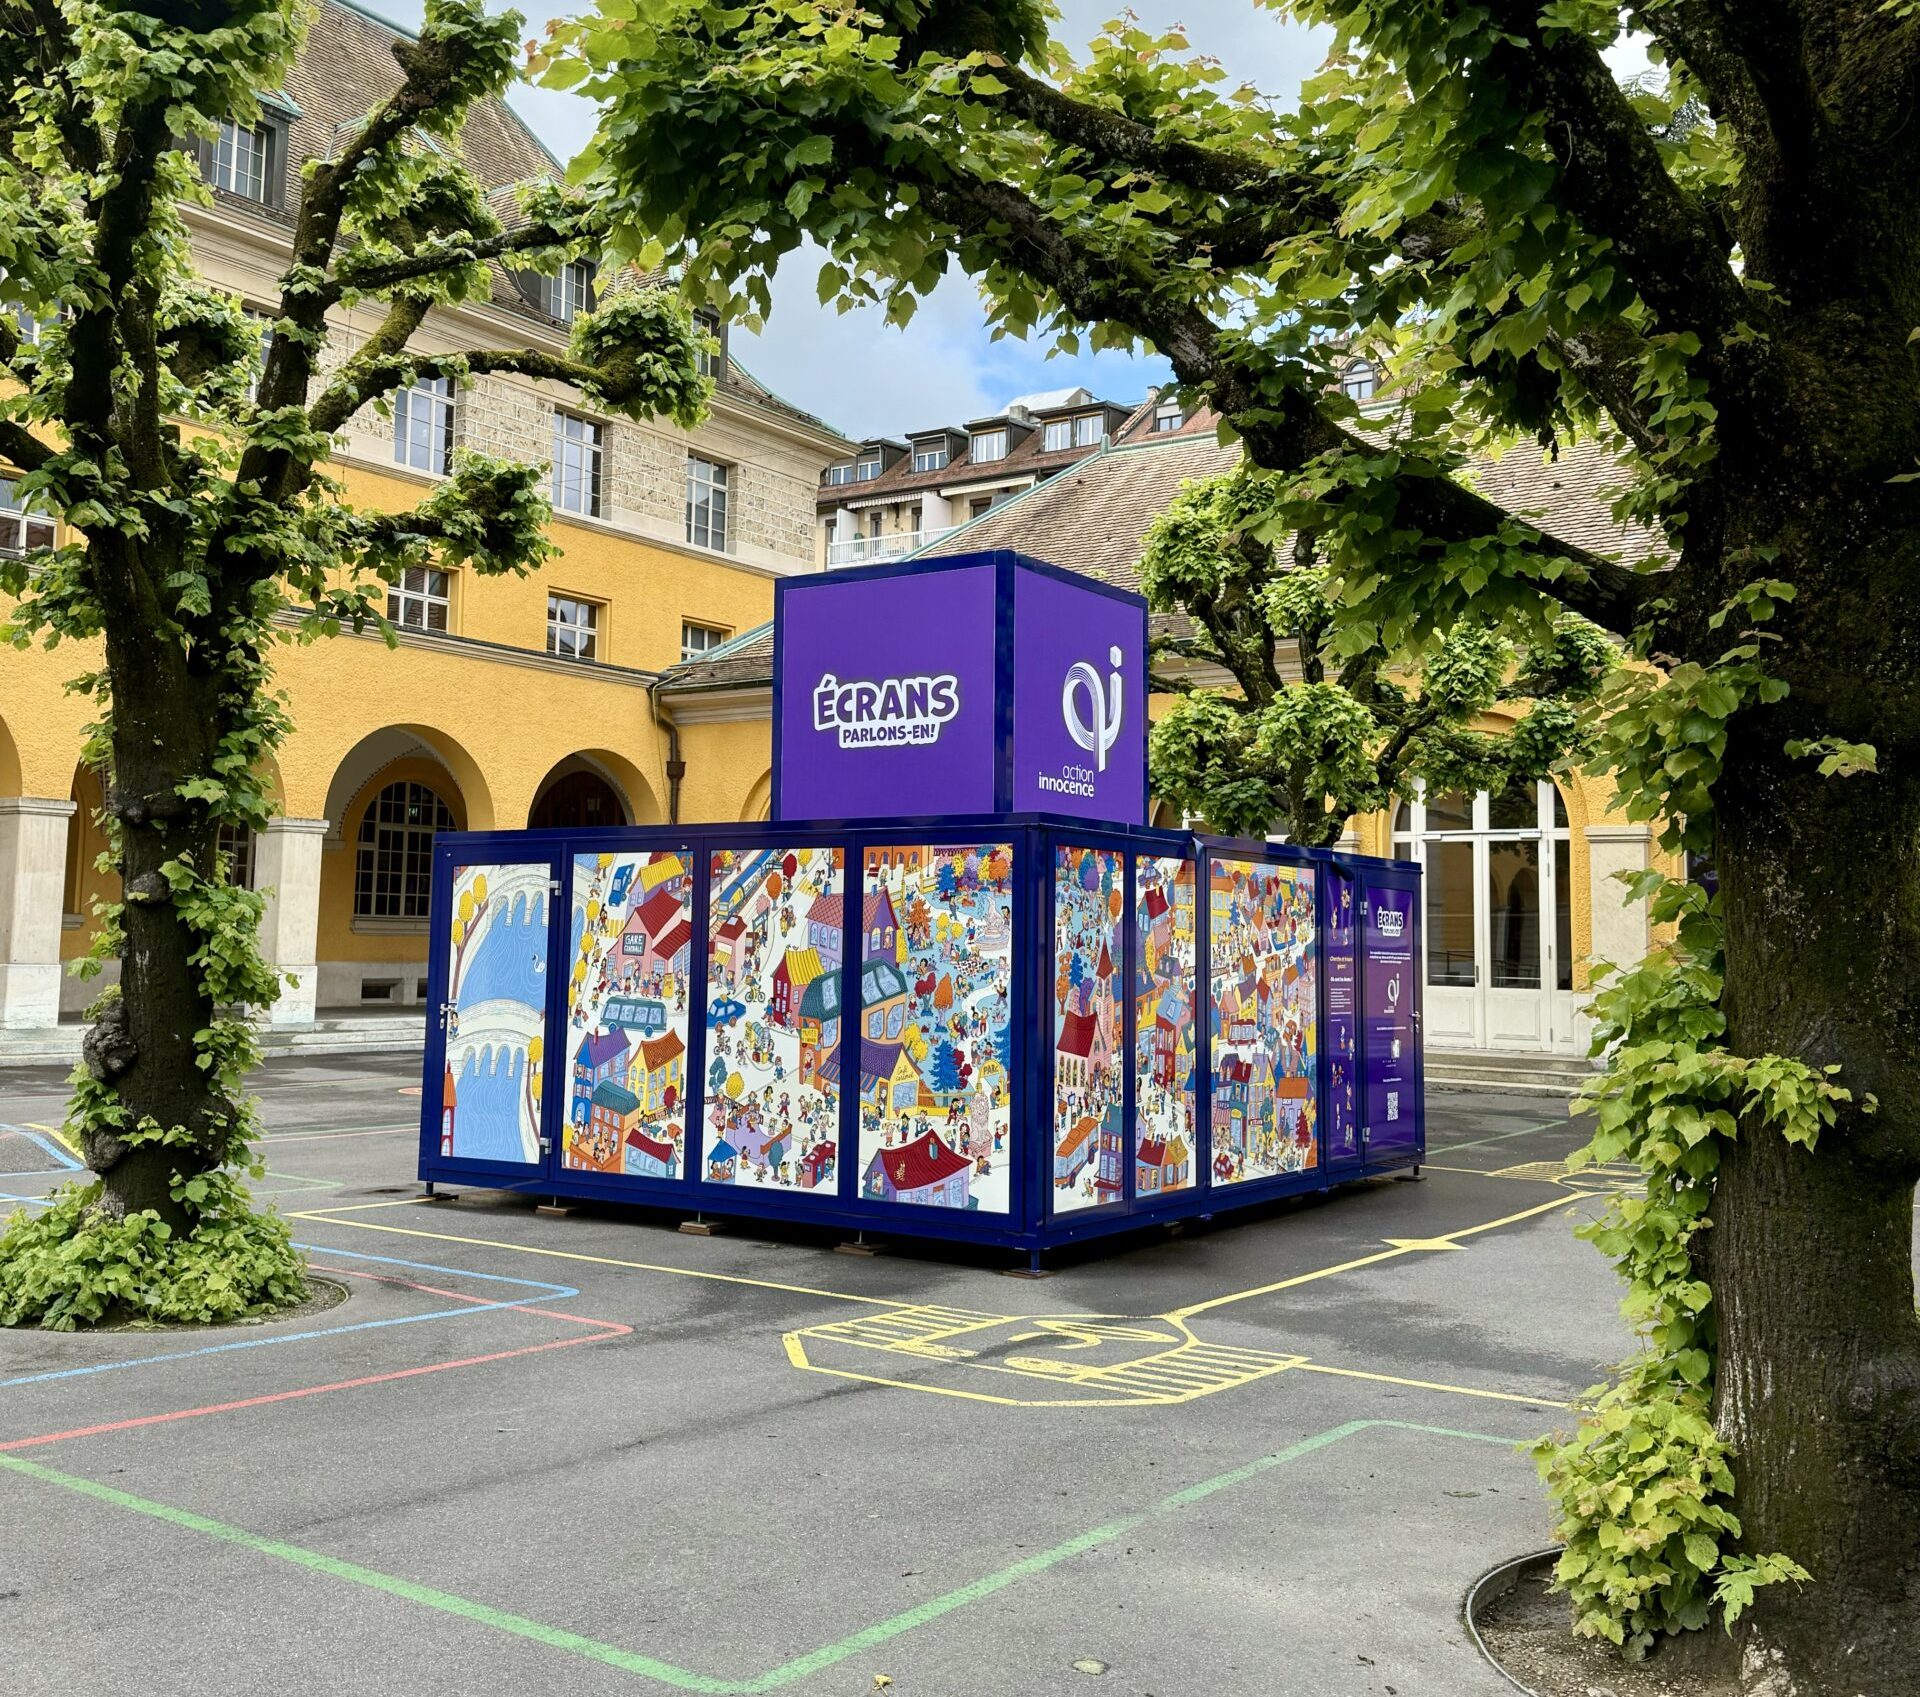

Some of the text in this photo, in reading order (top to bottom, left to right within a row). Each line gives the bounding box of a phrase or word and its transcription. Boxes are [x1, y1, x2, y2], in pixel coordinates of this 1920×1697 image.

[816, 677, 957, 727] ÉCRANS
[842, 723, 936, 744] PARLONS-EN!
[1062, 763, 1094, 783] action
[1038, 771, 1095, 798] innocence
[625, 934, 643, 945] GARE
[983, 1064, 999, 1075] PARC
